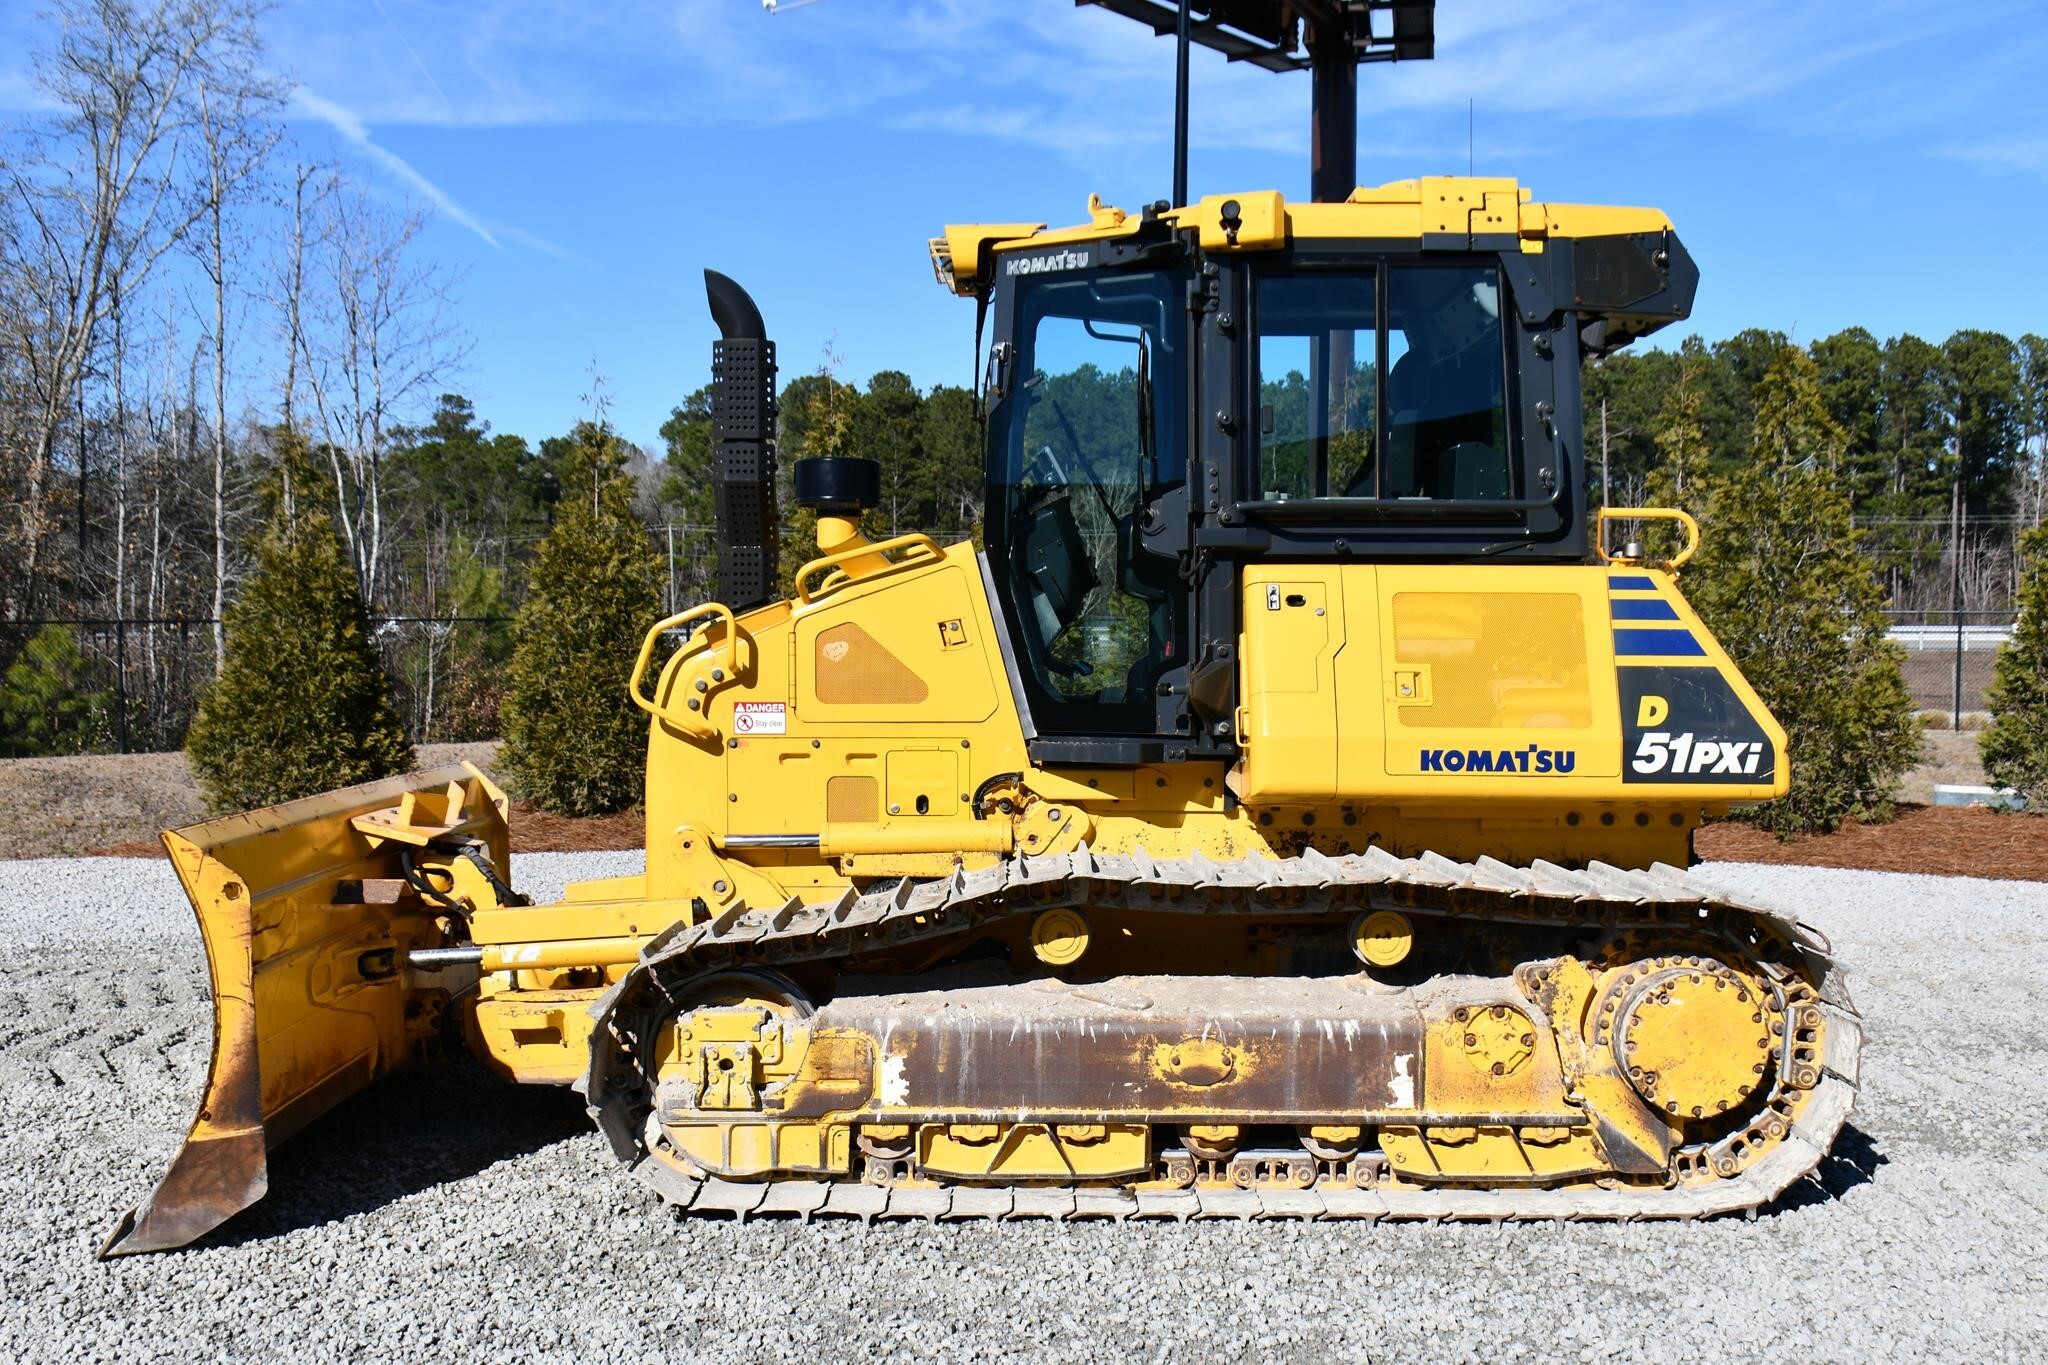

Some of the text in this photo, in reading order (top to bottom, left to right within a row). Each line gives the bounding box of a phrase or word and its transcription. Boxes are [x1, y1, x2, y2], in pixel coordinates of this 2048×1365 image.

[1006, 250, 1089, 275] KOMATSU
[745, 703, 785, 713] DANGER
[1636, 695, 1669, 727] D
[755, 719, 783, 728] Stay clear
[1420, 744, 1575, 773] KOMATSU
[1631, 732, 1763, 774] 51PXi
